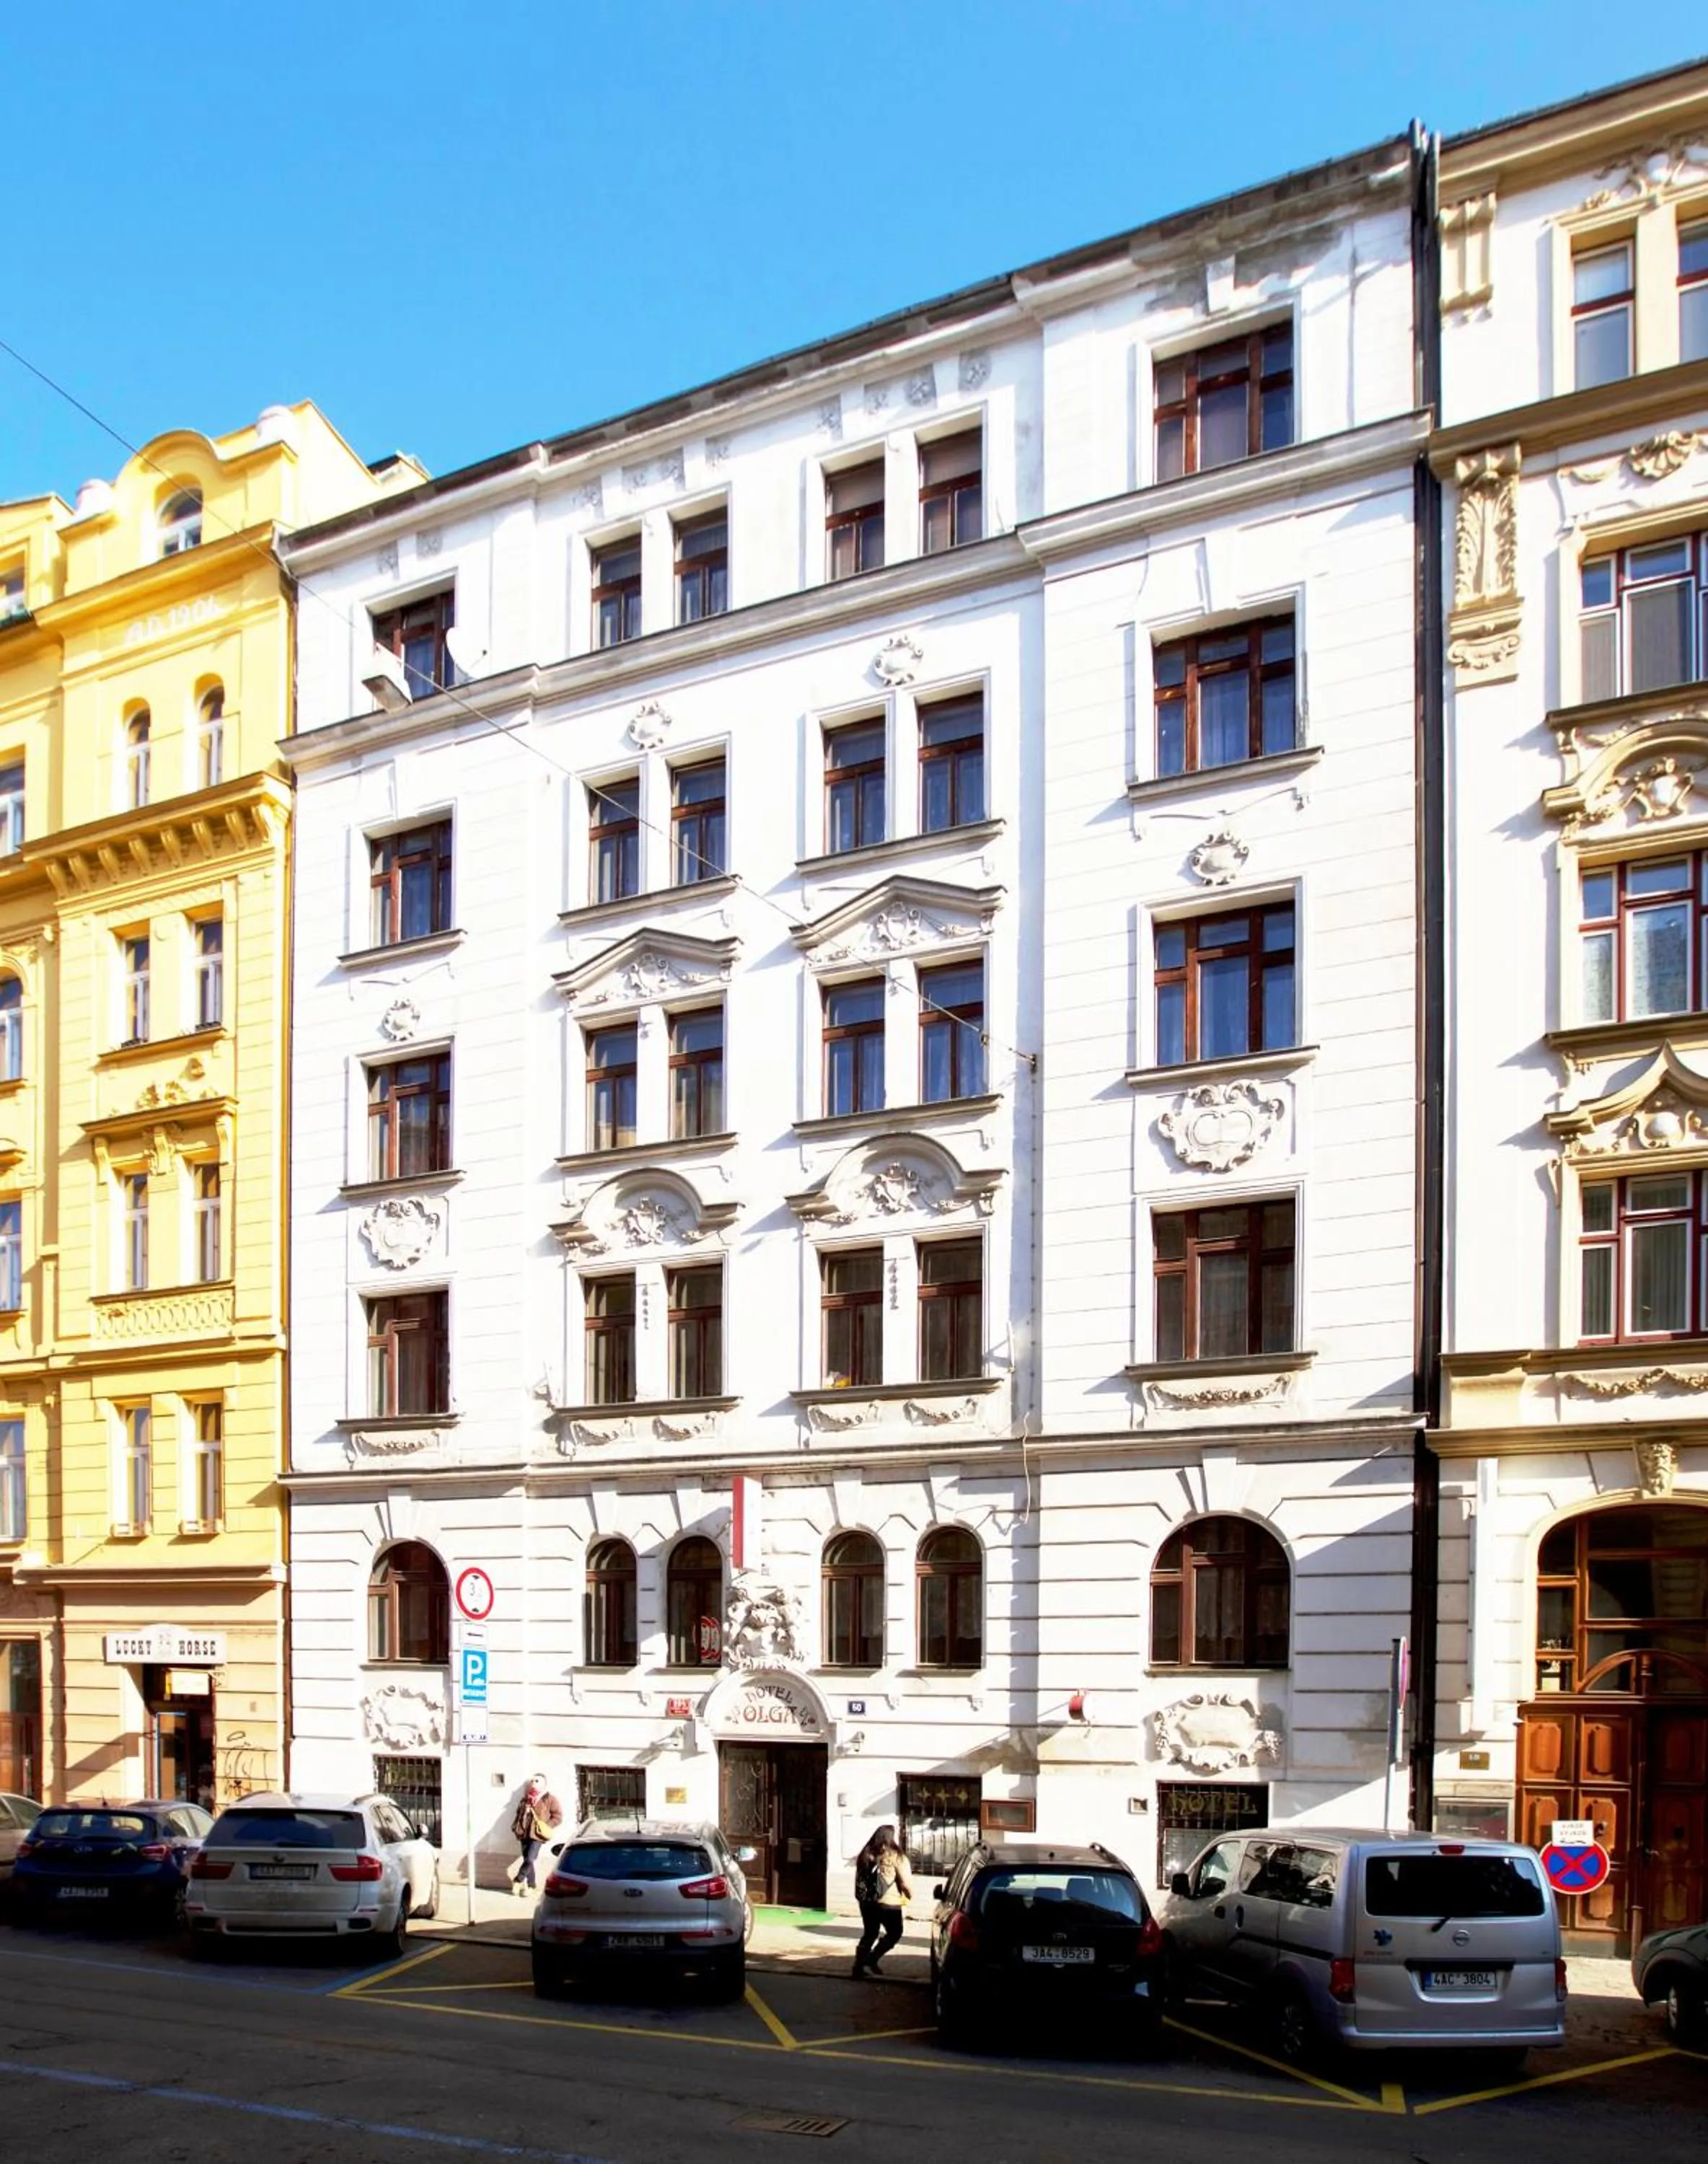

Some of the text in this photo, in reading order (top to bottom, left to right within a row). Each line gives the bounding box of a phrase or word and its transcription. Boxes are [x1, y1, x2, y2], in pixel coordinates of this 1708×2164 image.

[115, 1640, 216, 1656] LUCKY HORSE
[467, 1654, 483, 1686] P
[744, 1706, 797, 1723] OLGA
[1166, 1792, 1259, 1815] HOTEL
[1434, 1973, 1490, 1985] 4AC 3804
